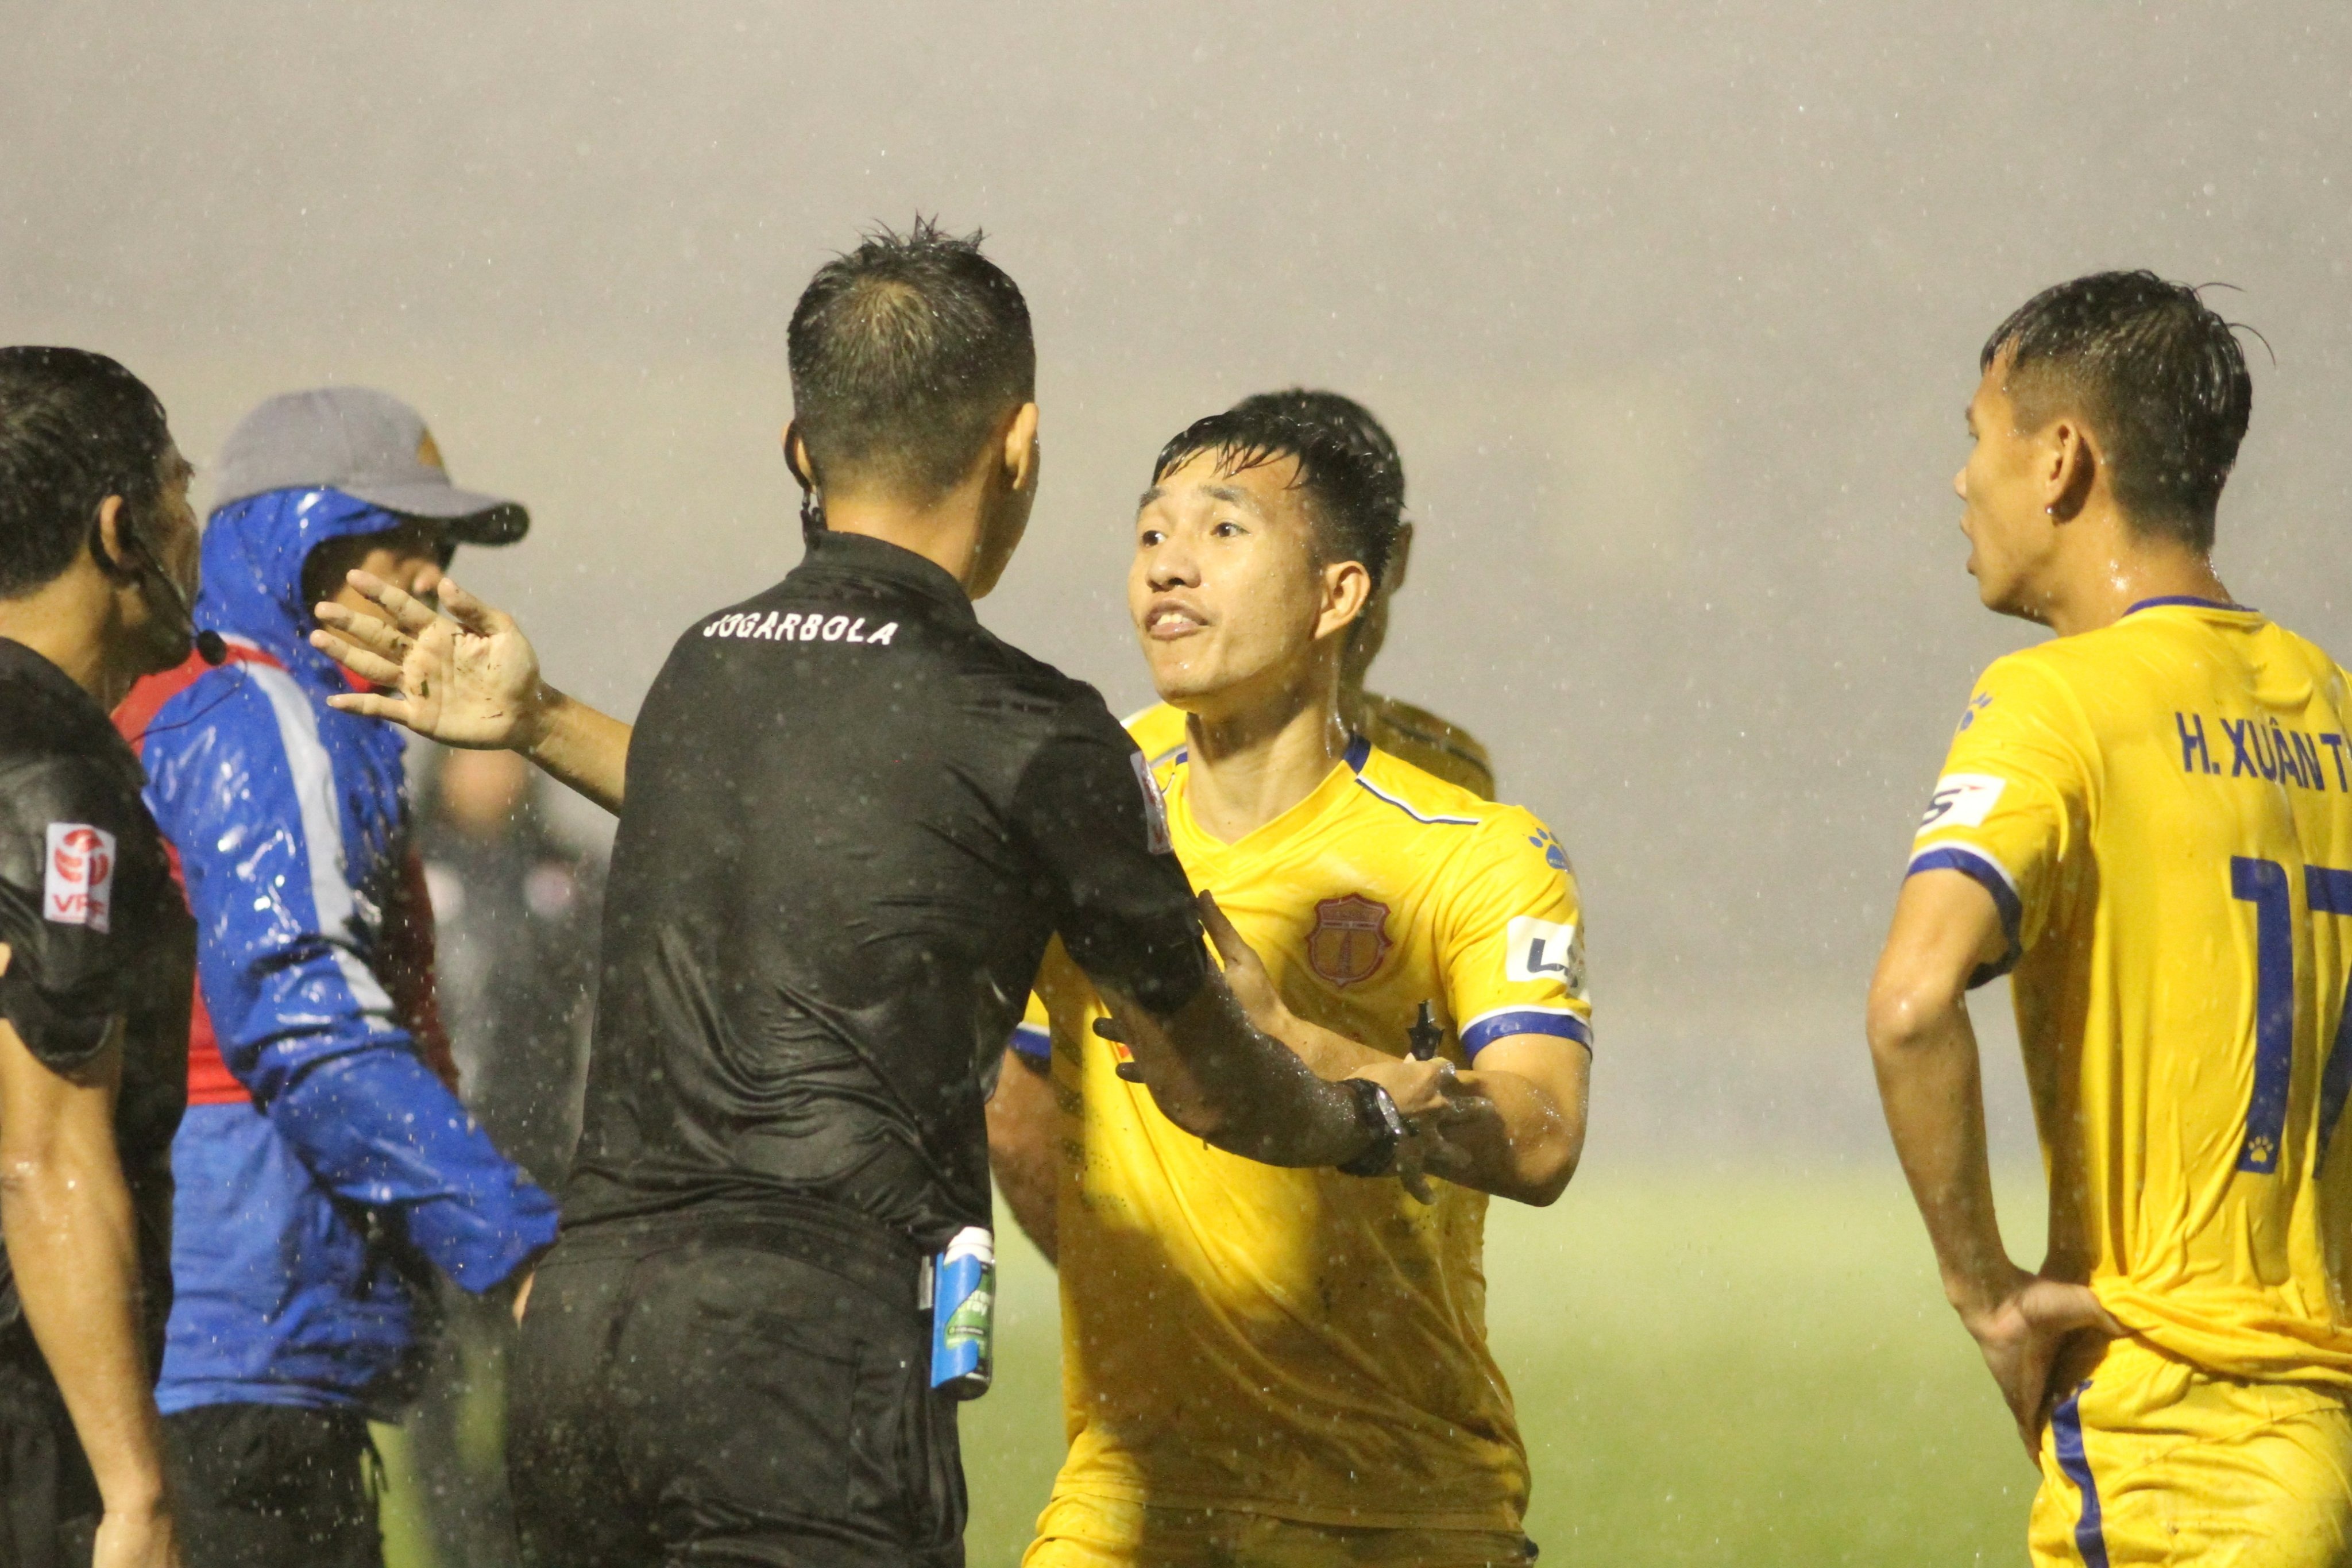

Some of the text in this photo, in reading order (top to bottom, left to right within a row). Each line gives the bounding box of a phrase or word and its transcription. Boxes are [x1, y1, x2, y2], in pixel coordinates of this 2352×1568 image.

[703, 611, 899, 646] JOGARBOLA
[2175, 712, 2221, 775] H.
[2219, 717, 2326, 791] XUÂN
